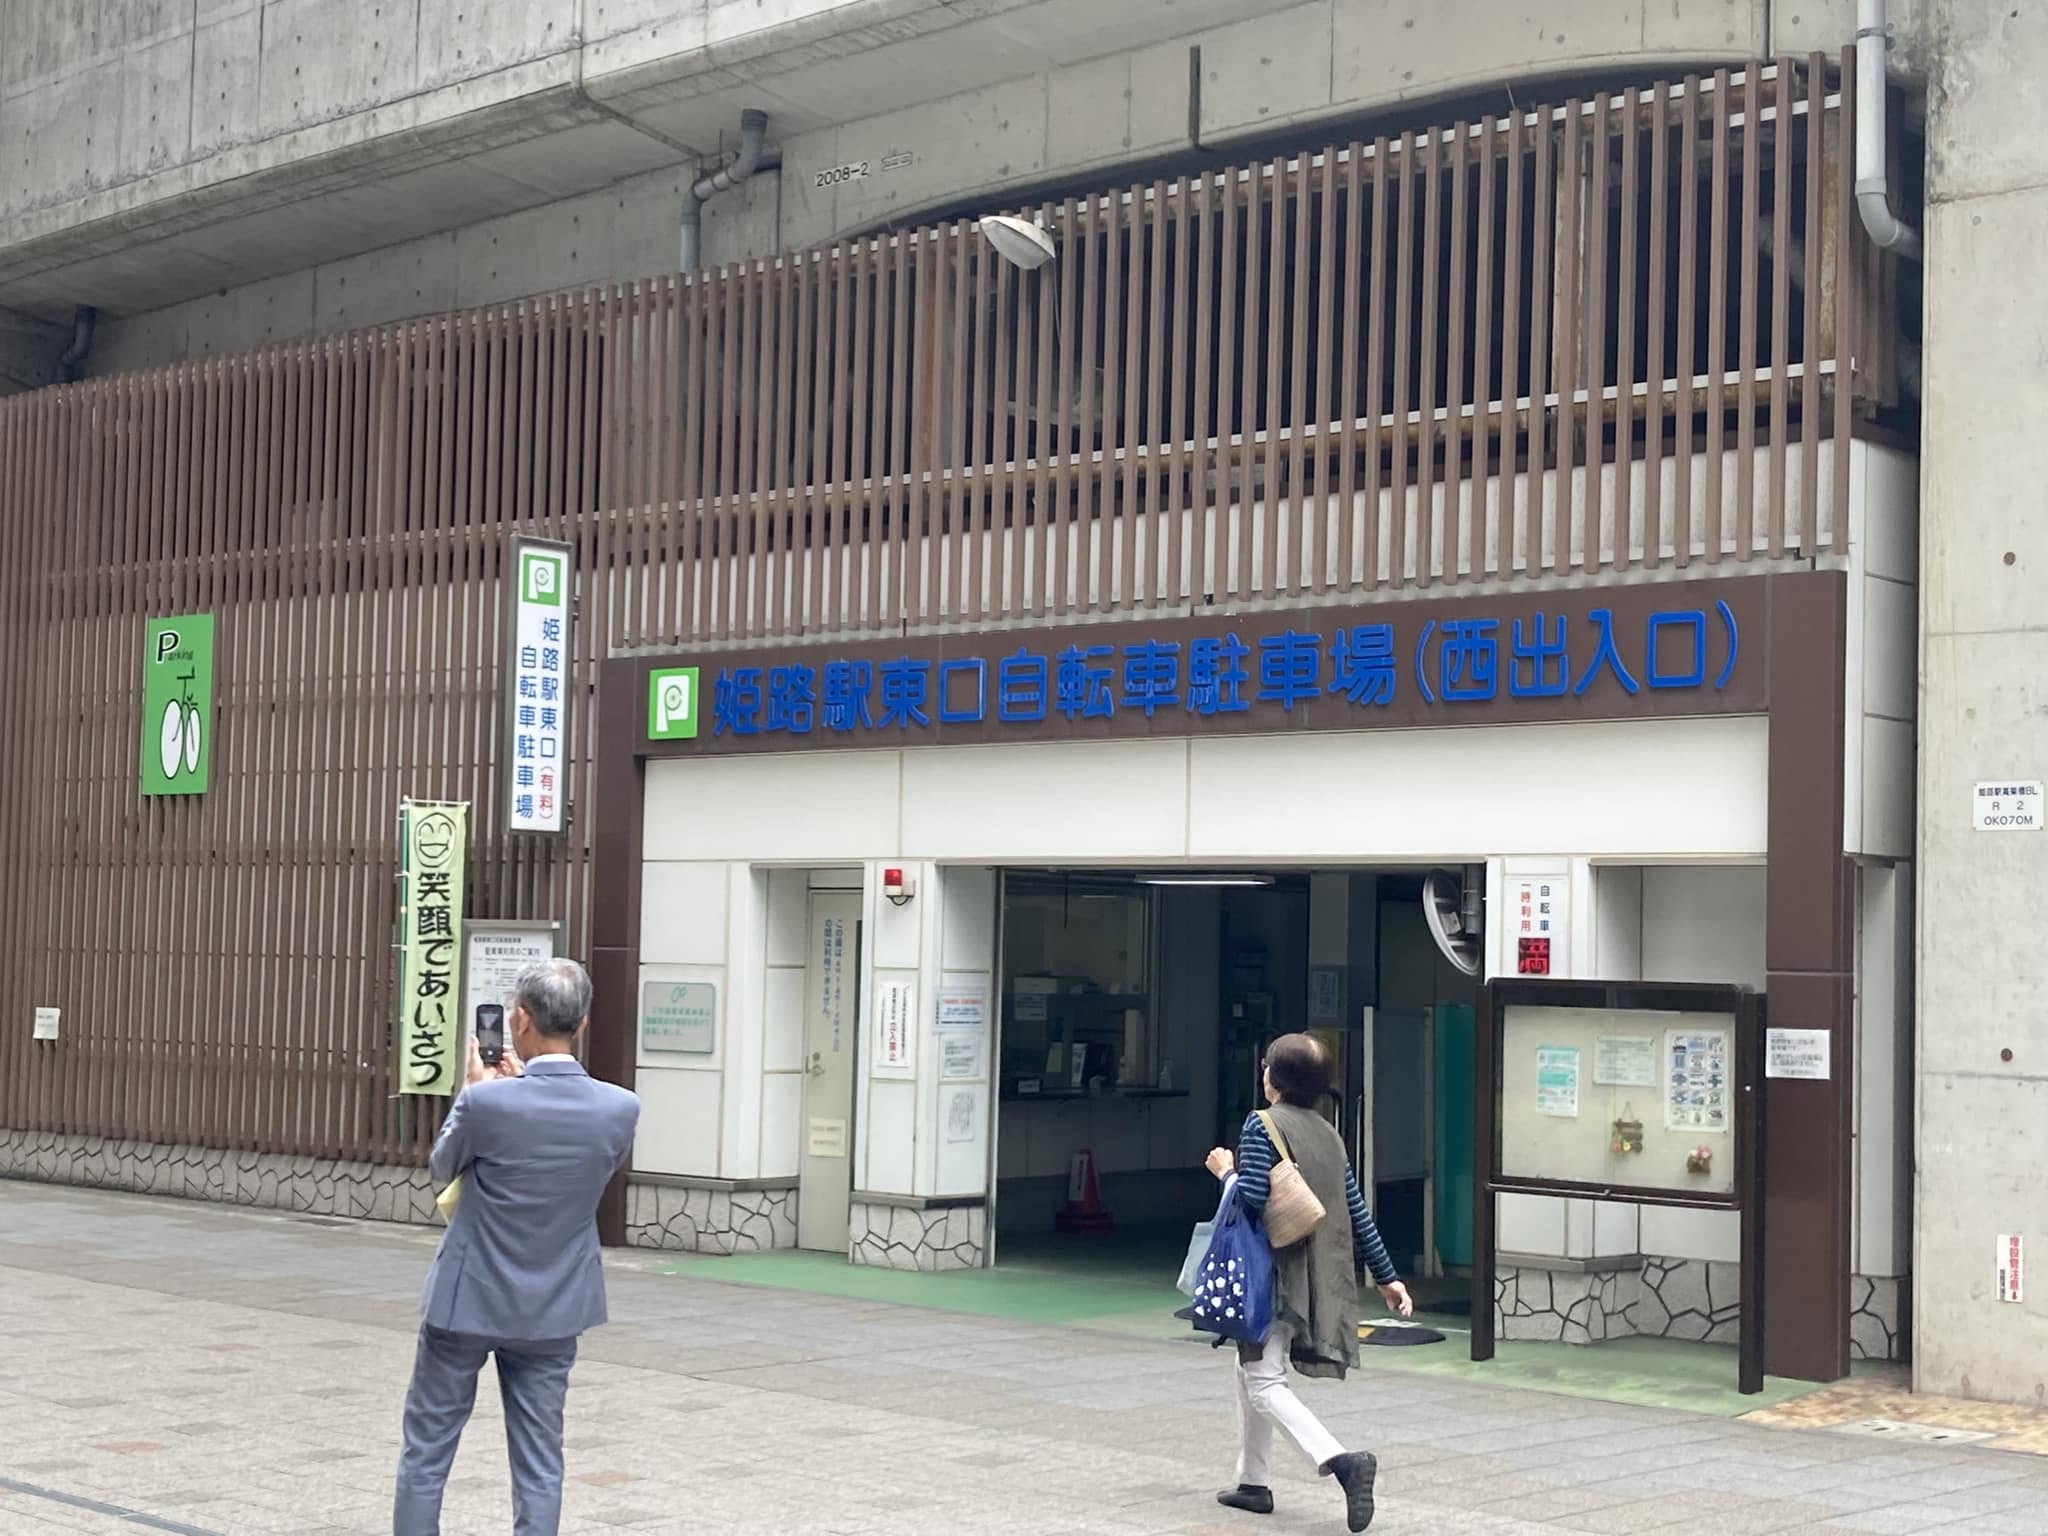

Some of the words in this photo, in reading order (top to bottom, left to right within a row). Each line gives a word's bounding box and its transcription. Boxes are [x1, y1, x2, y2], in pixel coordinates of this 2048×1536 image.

[815, 161, 870, 188] 2008-2
[712, 599, 1739, 736] 姫路駅東口自転車駐車場(西出入口)
[515, 645, 537, 819] 自転車駐車場
[2016, 800, 2025, 811] 2
[1521, 882, 1531, 932] 一時利用
[1540, 885, 1550, 931] 自転車
[409, 871, 454, 1087] 笑顔であいさつ
